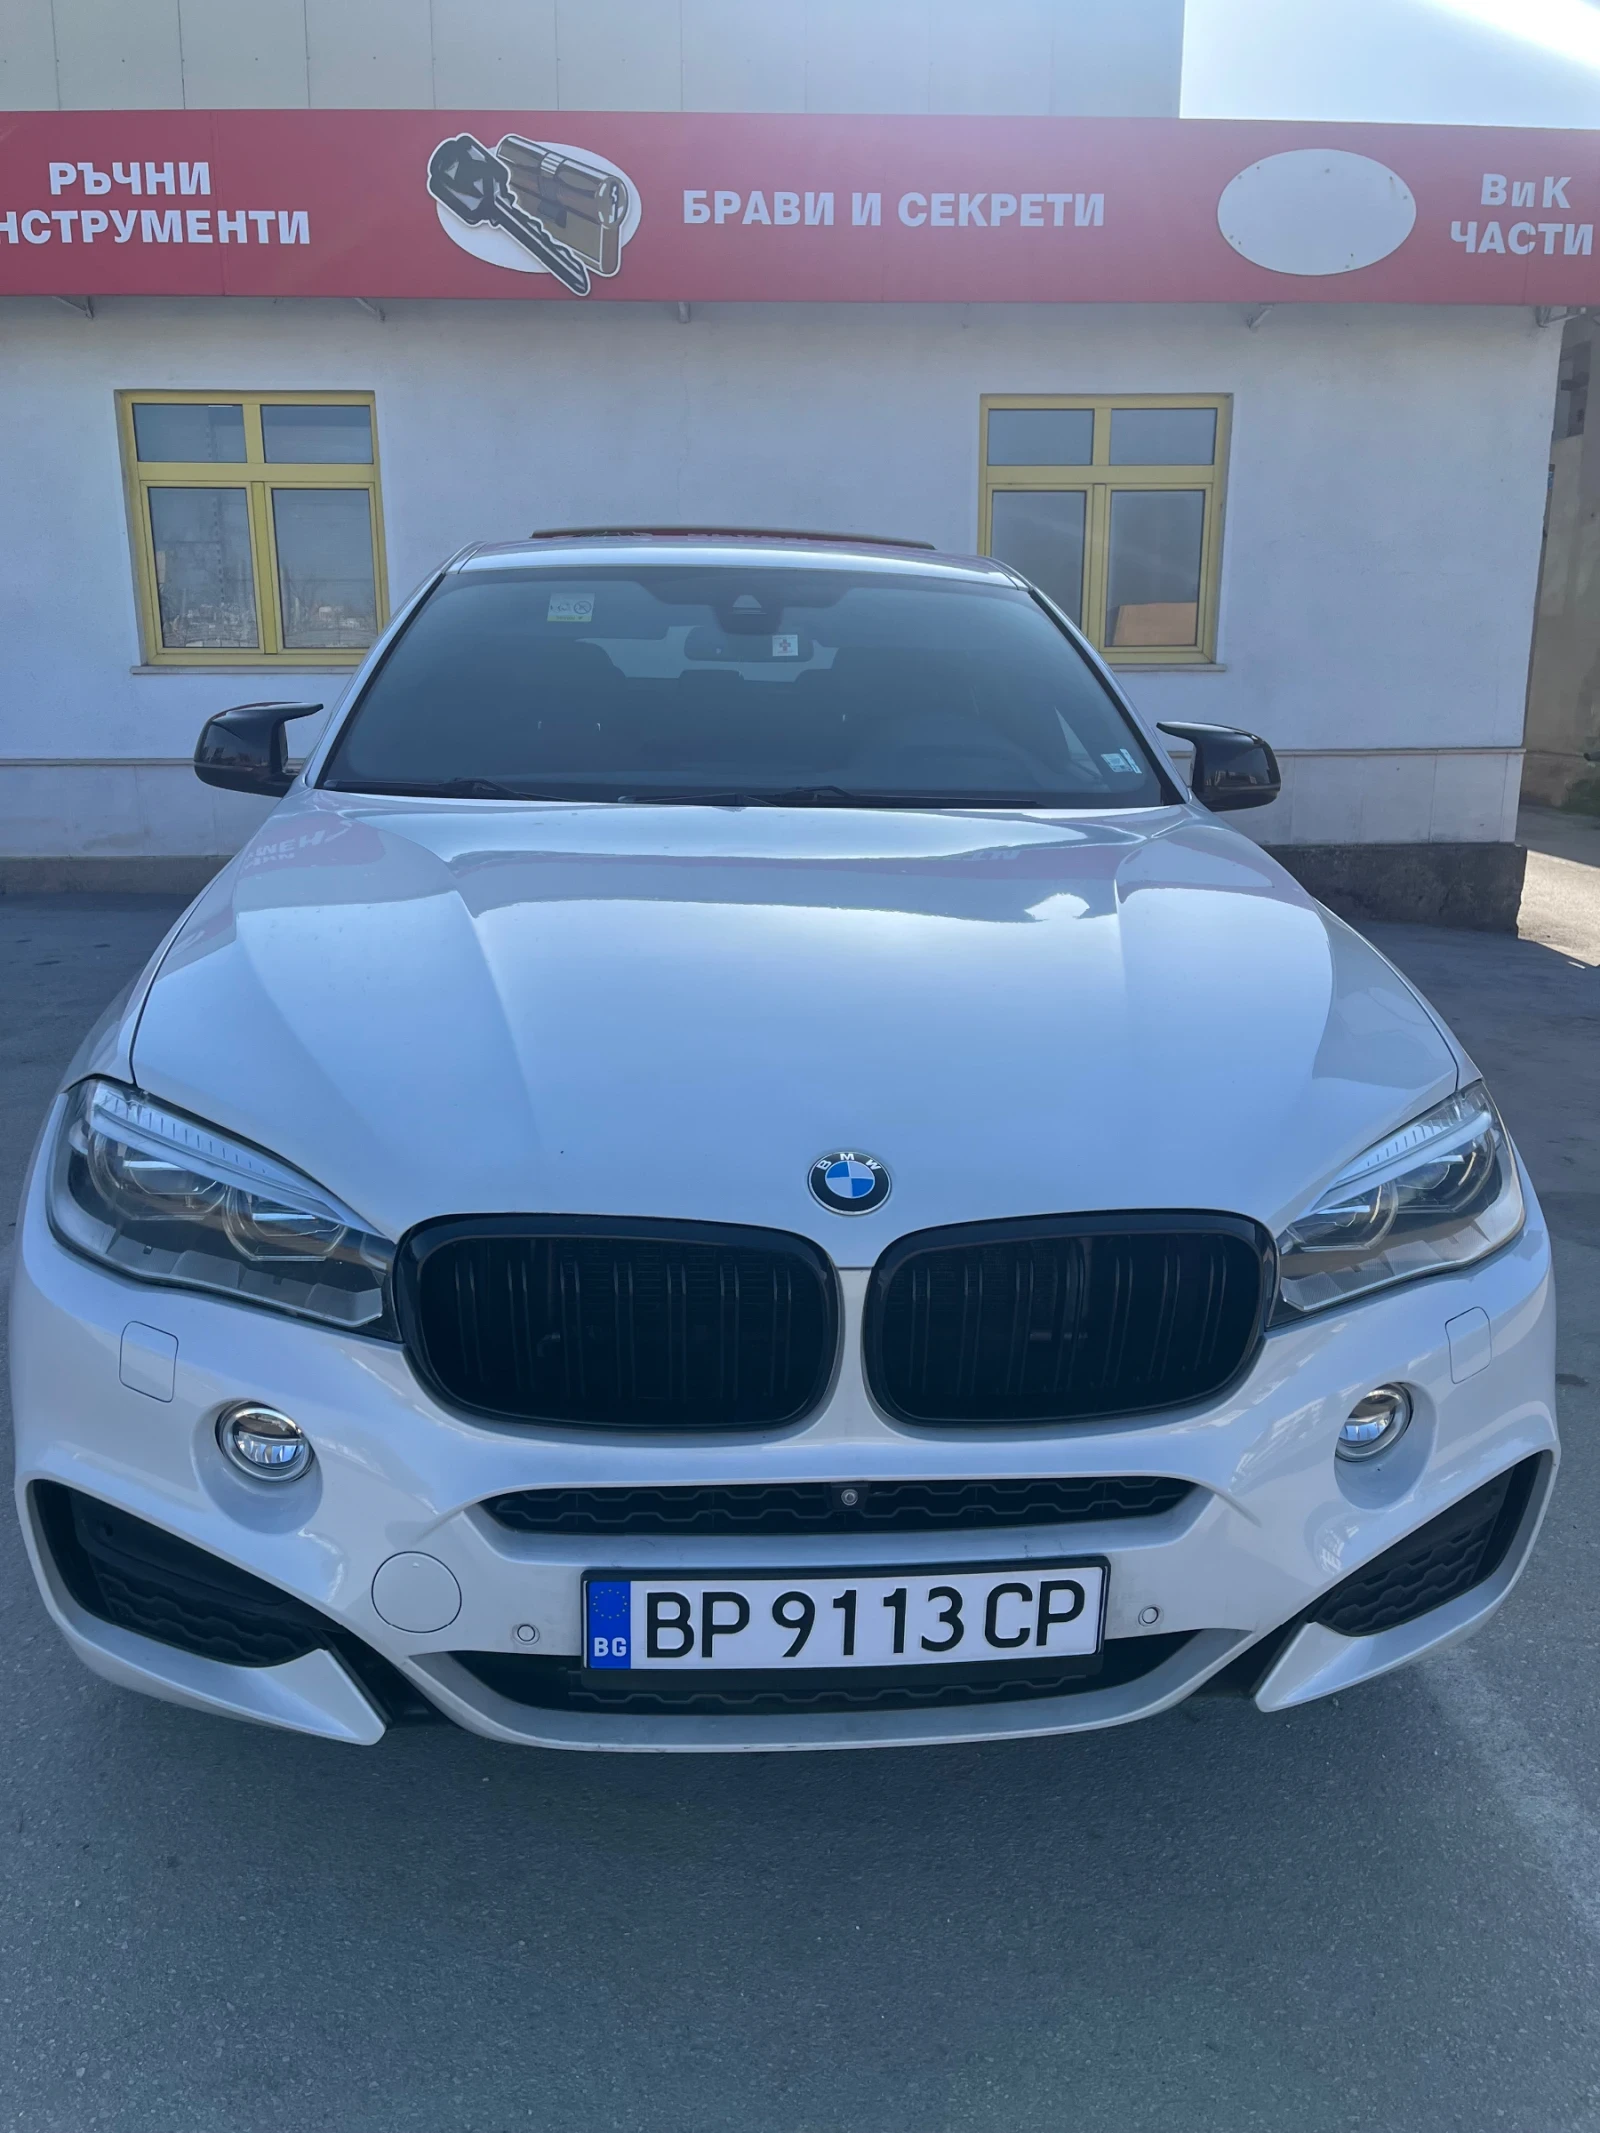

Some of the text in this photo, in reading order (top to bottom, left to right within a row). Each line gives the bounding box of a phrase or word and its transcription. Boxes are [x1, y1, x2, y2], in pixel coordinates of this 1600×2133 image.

[48, 161, 211, 195] РЪЧНИ
[1480, 173, 1572, 209] ВиК
[683, 189, 1105, 227] БРАВИ И СЕКРЕТИ
[1450, 220, 1594, 256] ЧАСТИ
[816, 1153, 881, 1170] BMW
[646, 1579, 1086, 1659] BP 9113 CP
[594, 1636, 627, 1657] BG
